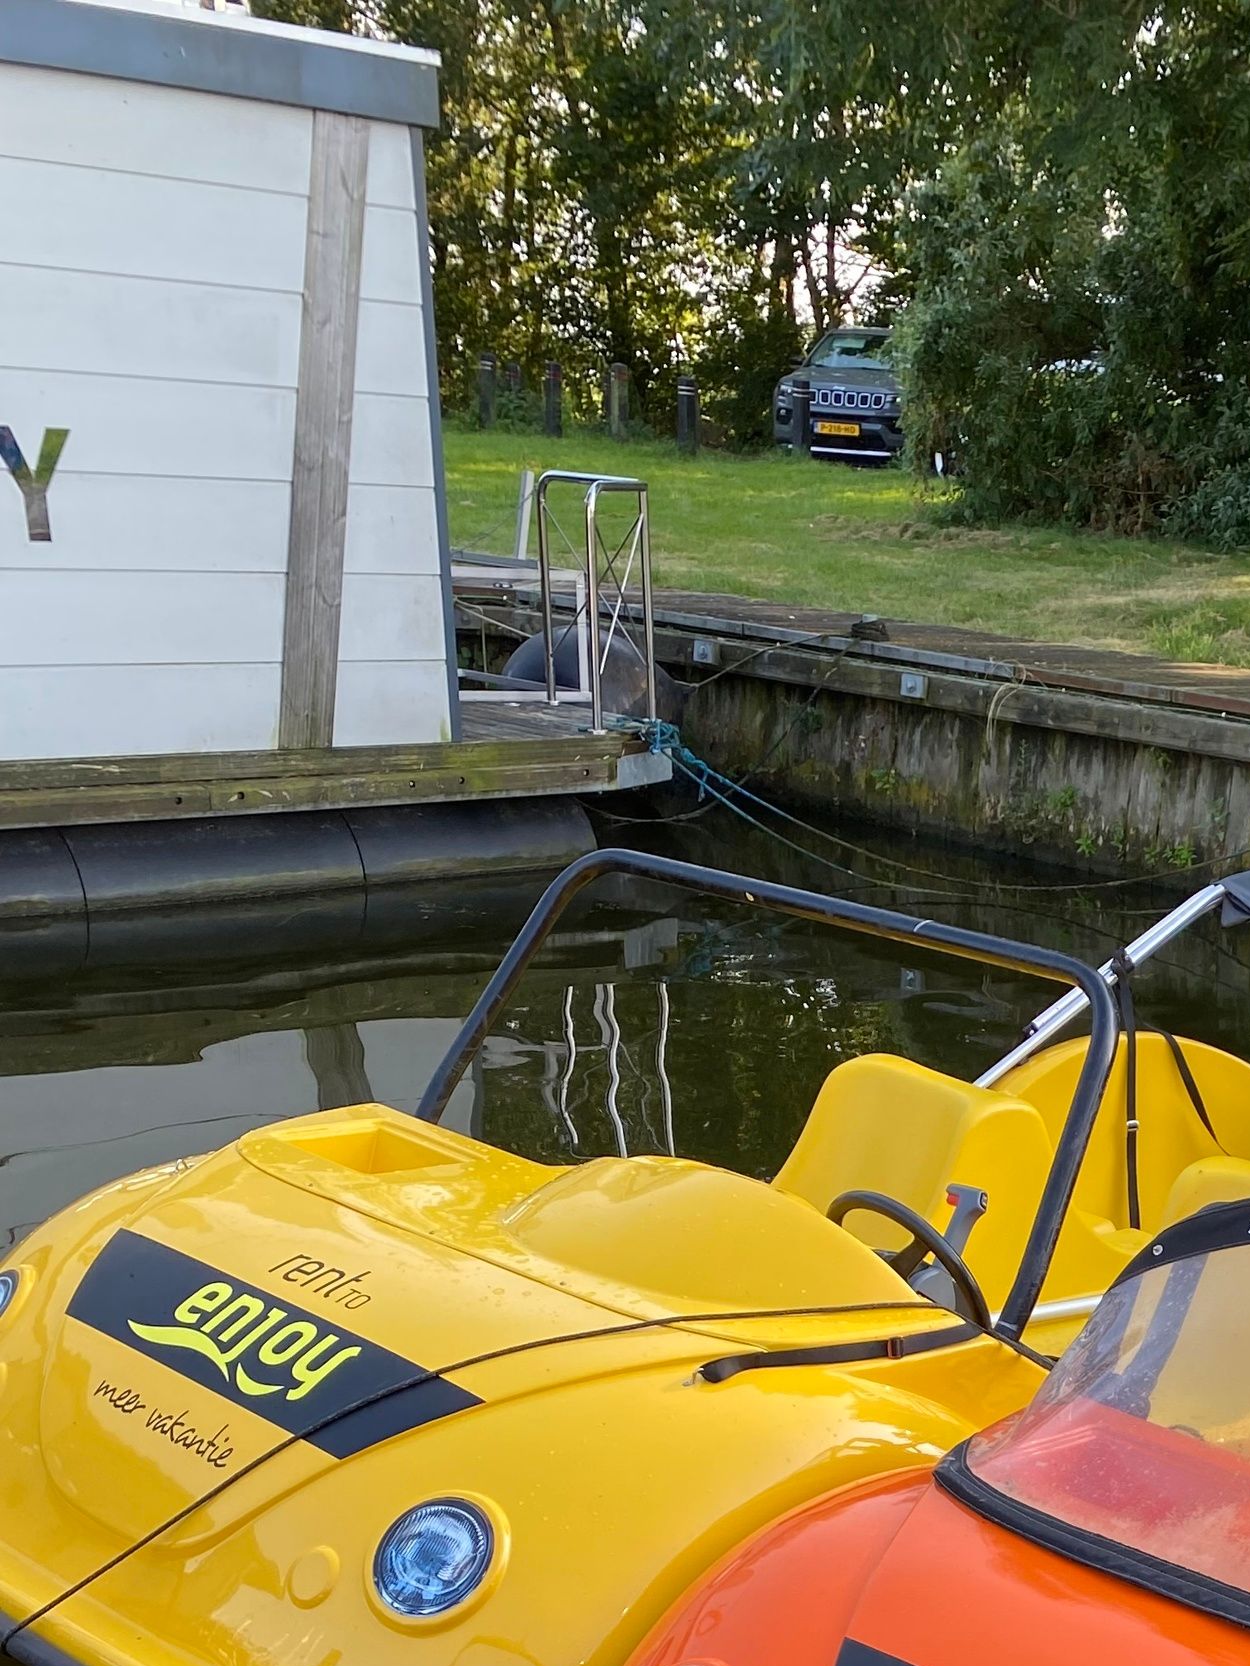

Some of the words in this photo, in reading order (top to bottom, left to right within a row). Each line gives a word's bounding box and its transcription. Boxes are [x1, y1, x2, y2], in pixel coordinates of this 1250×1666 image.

[268, 1253, 371, 1298] rent
[335, 1288, 371, 1310] TO
[172, 1280, 363, 1401] enjoy
[93, 1378, 147, 1414] meer
[145, 1408, 235, 1468] vakantie
